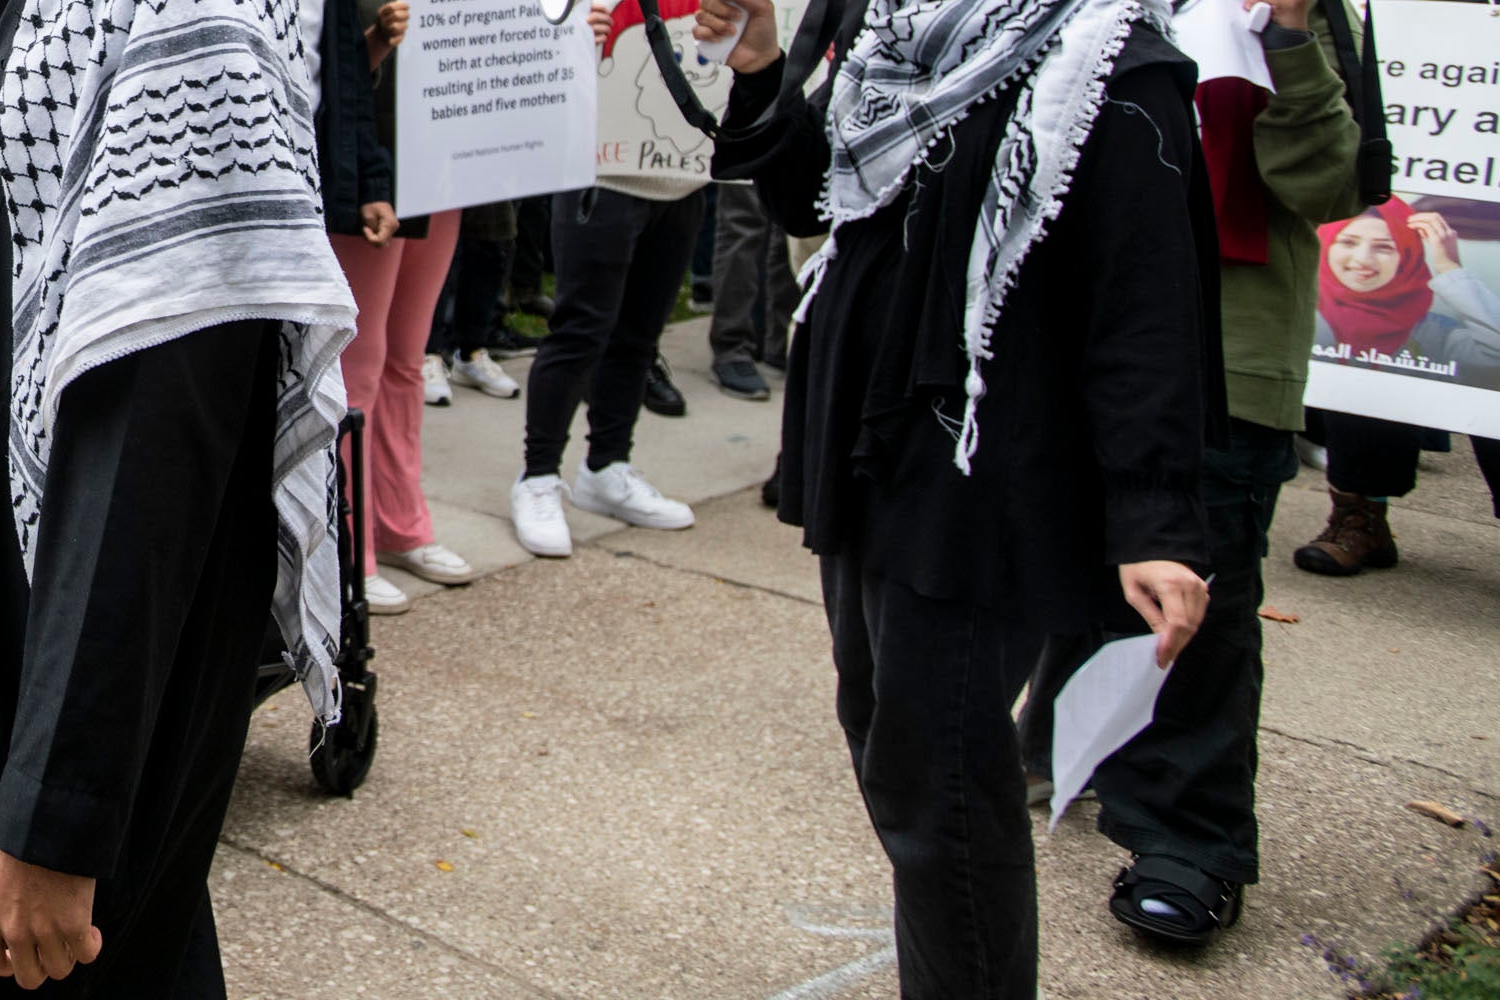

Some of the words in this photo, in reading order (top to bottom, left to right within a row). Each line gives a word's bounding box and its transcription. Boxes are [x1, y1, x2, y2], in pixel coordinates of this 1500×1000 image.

[419, 13, 446, 28] 10%
[448, 11, 462, 25] of
[463, 7, 516, 27] pregnant
[422, 37, 466, 51] women
[469, 32, 498, 46] were
[500, 26, 537, 42] forced
[539, 27, 551, 38] to
[553, 25, 575, 40] give
[438, 56, 467, 72] birth
[470, 56, 482, 69] at
[484, 49, 553, 67] checkpoints
[1377, 59, 1406, 78] e
[423, 80, 474, 98] resulting
[476, 78, 488, 91] in
[490, 74, 510, 89] the
[512, 71, 545, 87] death
[547, 69, 559, 82] of
[561, 67, 574, 80] 35
[431, 106, 469, 121] babies
[471, 100, 493, 114] and
[495, 97, 517, 112] five
[519, 91, 567, 108] mothers
